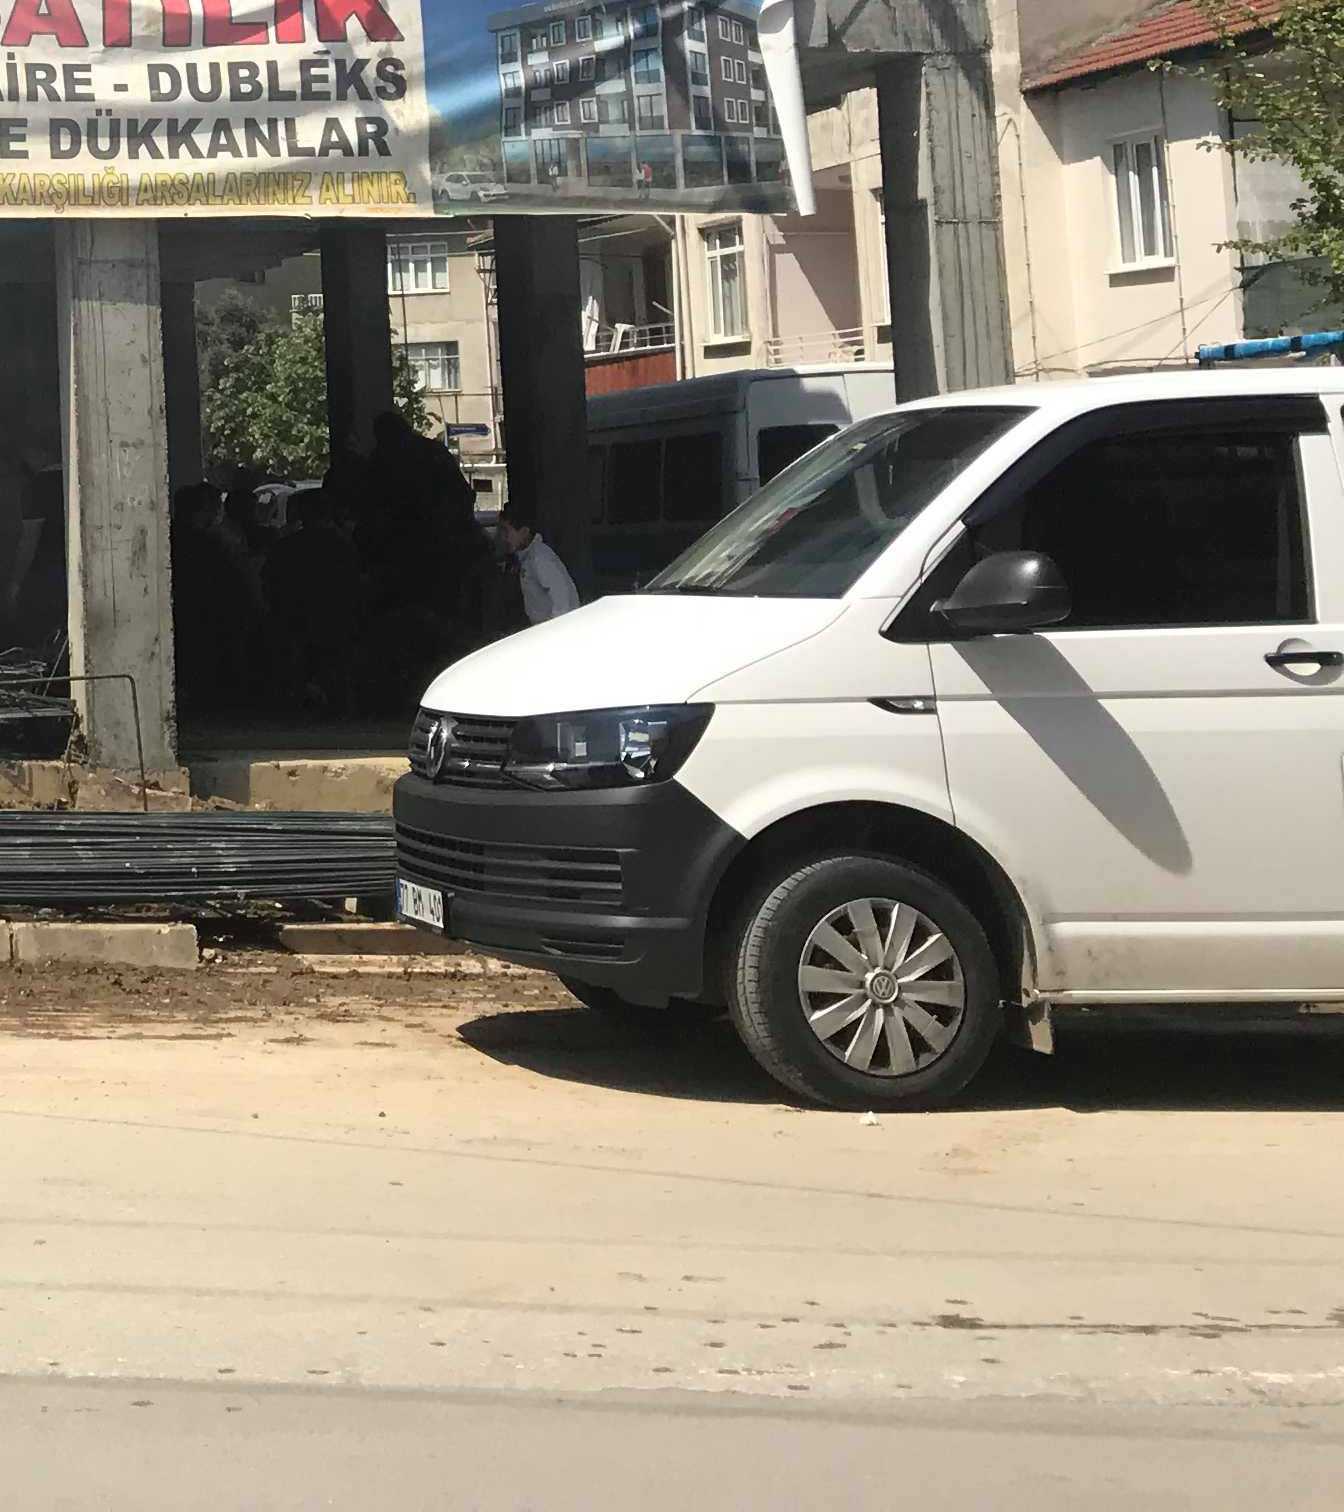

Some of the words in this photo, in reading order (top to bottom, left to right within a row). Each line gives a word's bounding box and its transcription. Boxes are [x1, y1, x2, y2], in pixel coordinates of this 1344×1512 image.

[146, 56, 408, 104] DUBLEKS
[48, 108, 393, 160] DÜKKANLAR
[135, 170, 314, 206] ARSALARINIZ
[318, 170, 417, 205] ALINIR.
